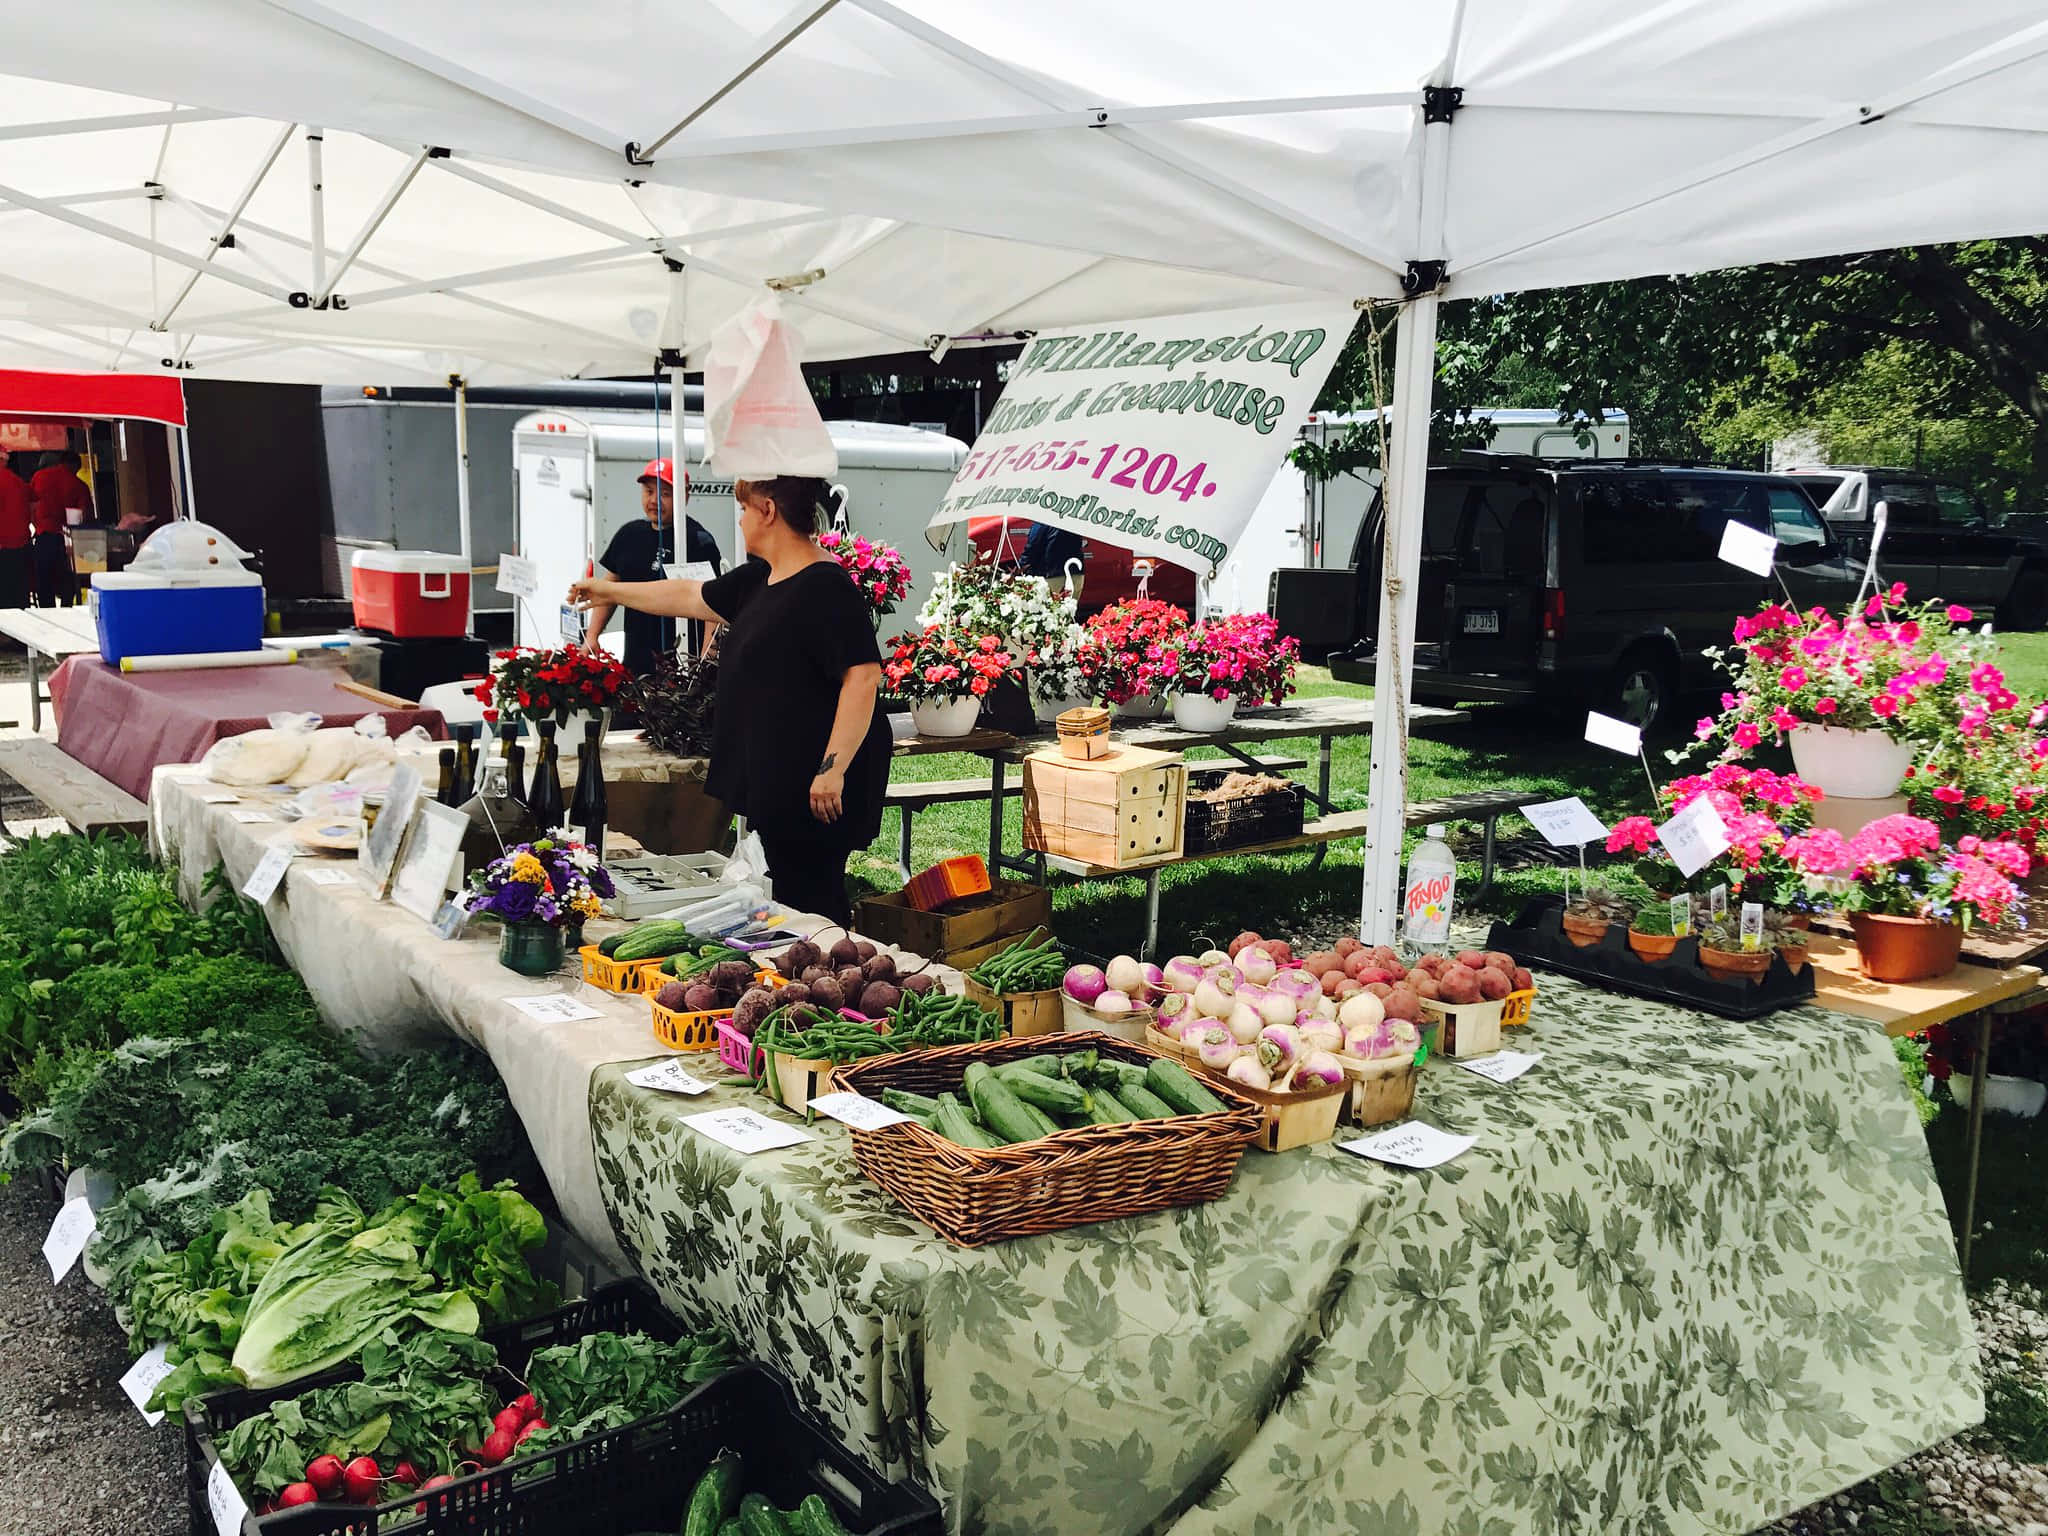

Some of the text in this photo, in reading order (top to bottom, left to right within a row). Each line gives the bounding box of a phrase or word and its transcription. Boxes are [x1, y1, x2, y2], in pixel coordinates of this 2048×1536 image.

[1015, 323, 1327, 378] Williamston
[984, 372, 1286, 434] lorist & Greenhouse
[1407, 875, 1450, 918] Faygo
